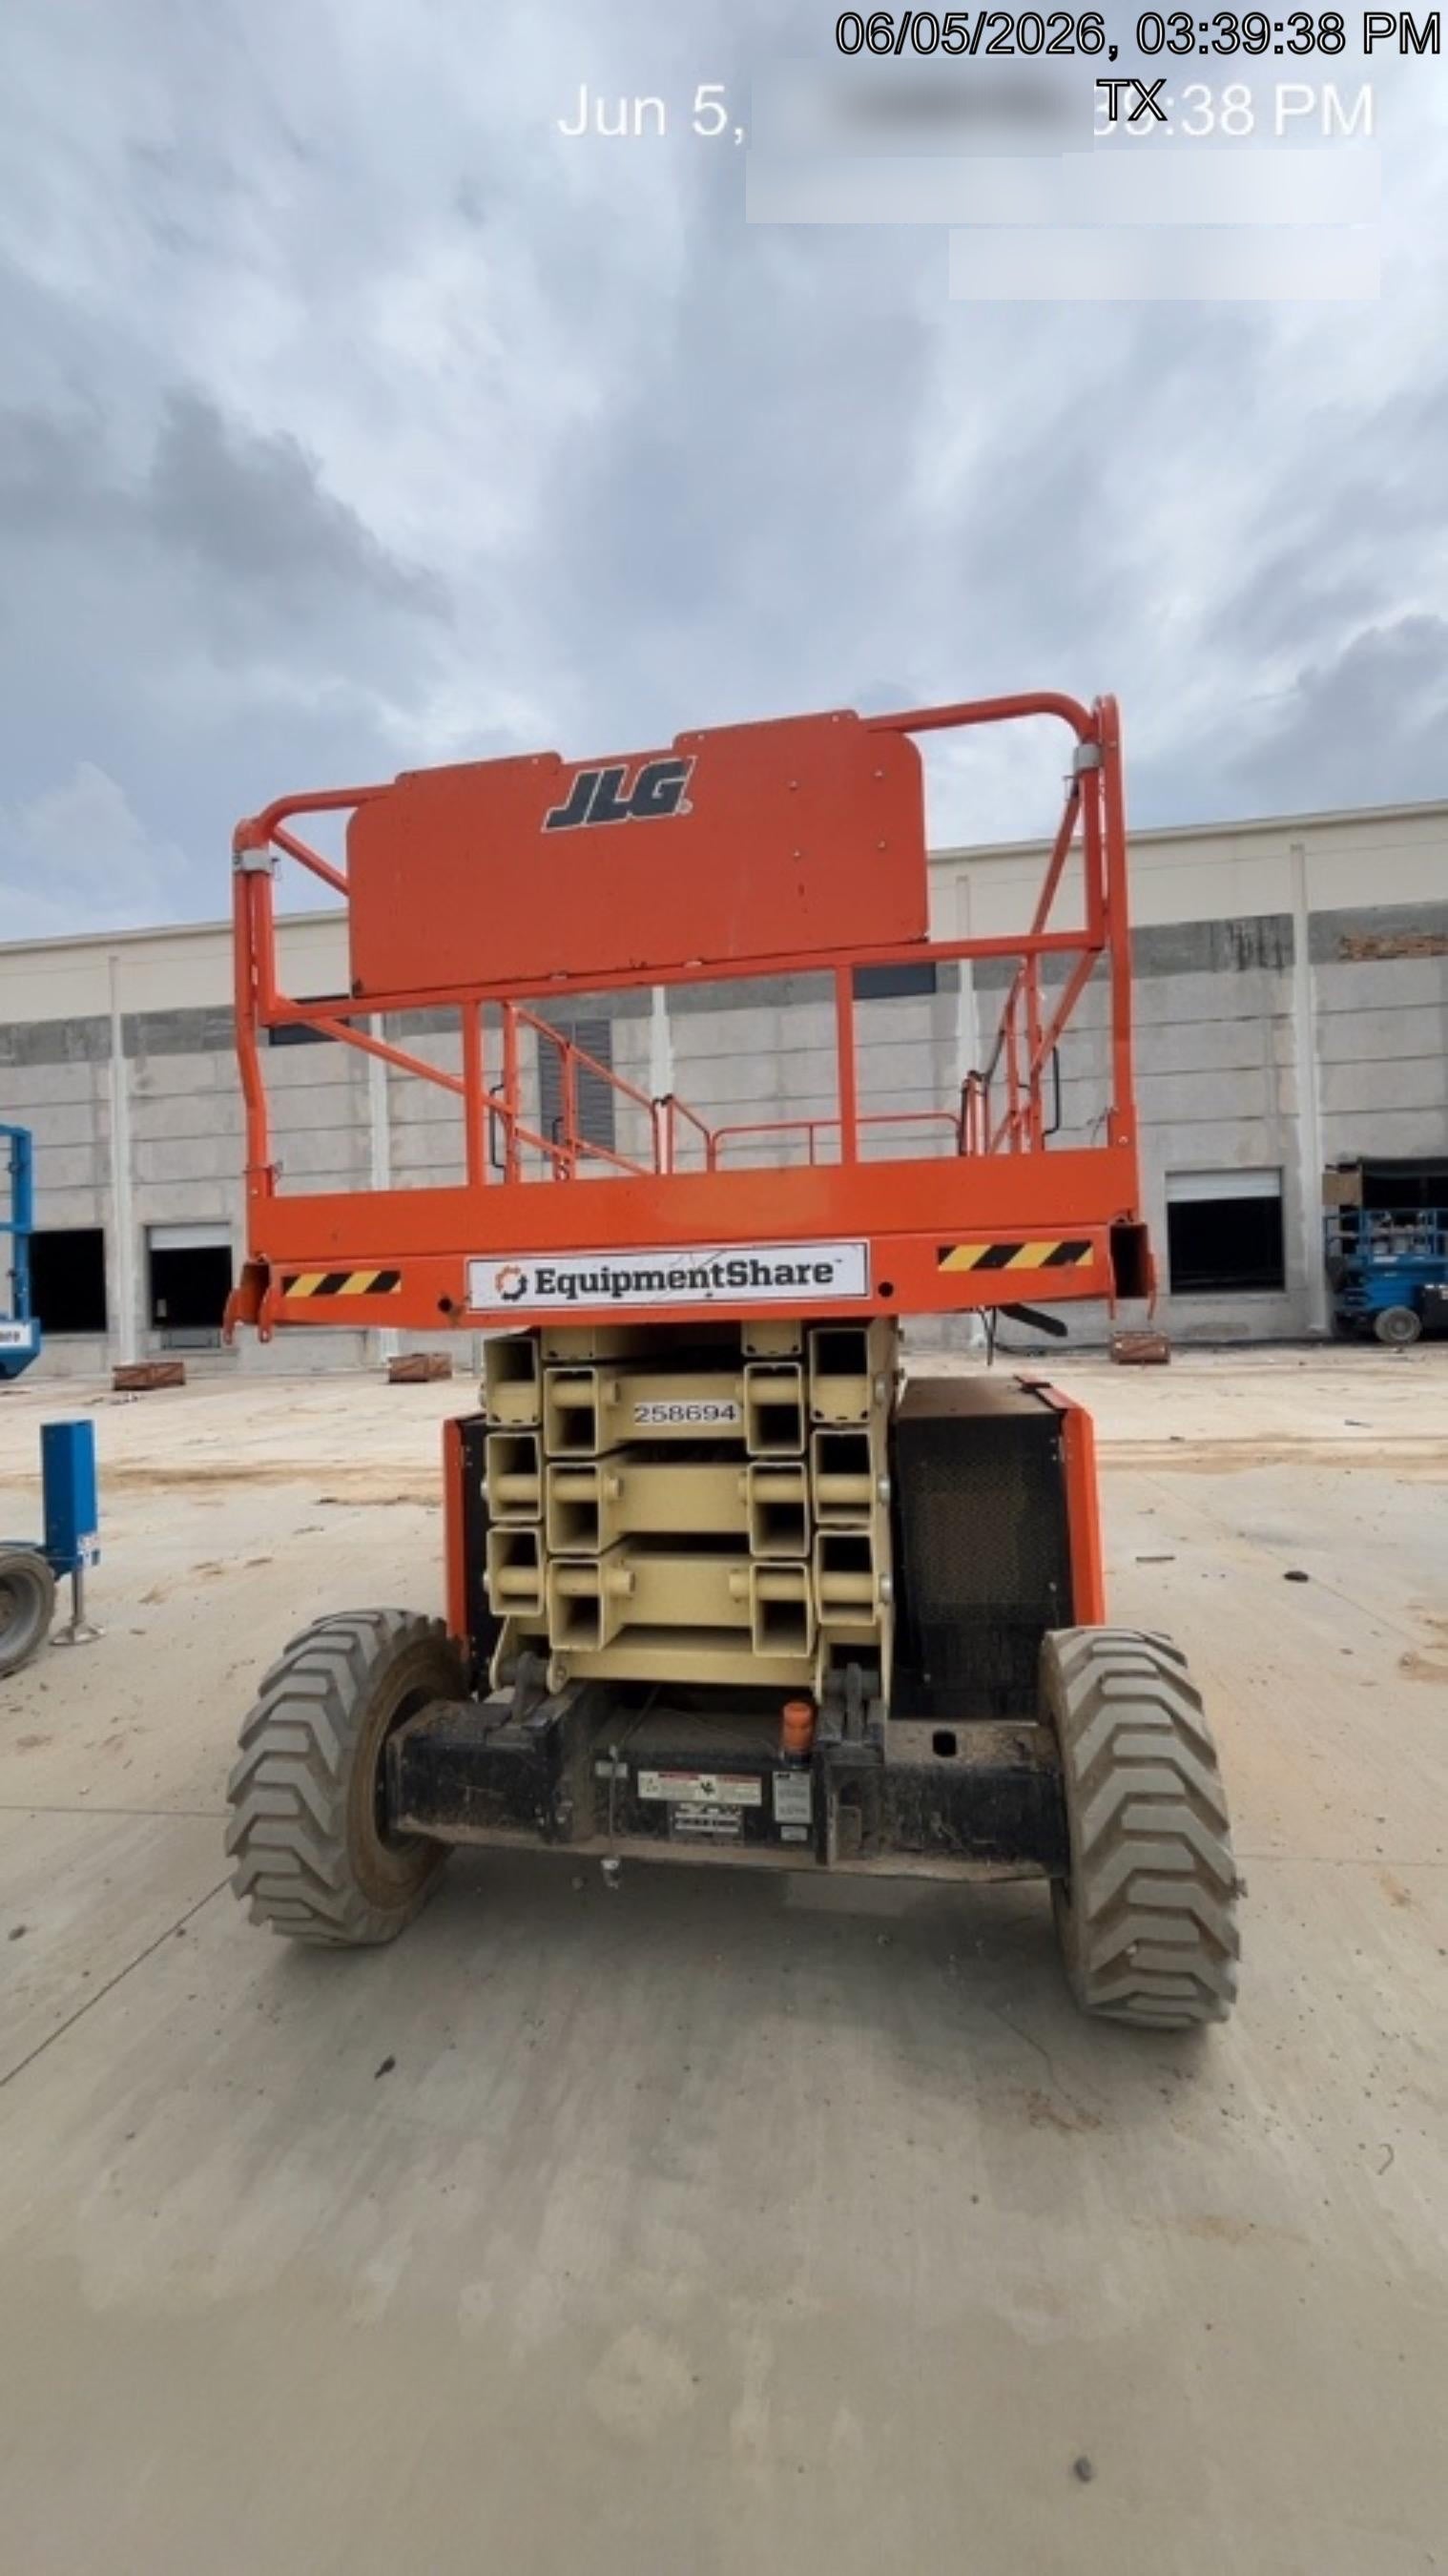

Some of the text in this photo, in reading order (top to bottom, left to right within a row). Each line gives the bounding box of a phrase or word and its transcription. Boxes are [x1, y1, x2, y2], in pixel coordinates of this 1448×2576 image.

[542, 756, 697, 833] JLG
[535, 1257, 835, 1299] EquipmentShare
[634, 1403, 735, 1423] 258694
